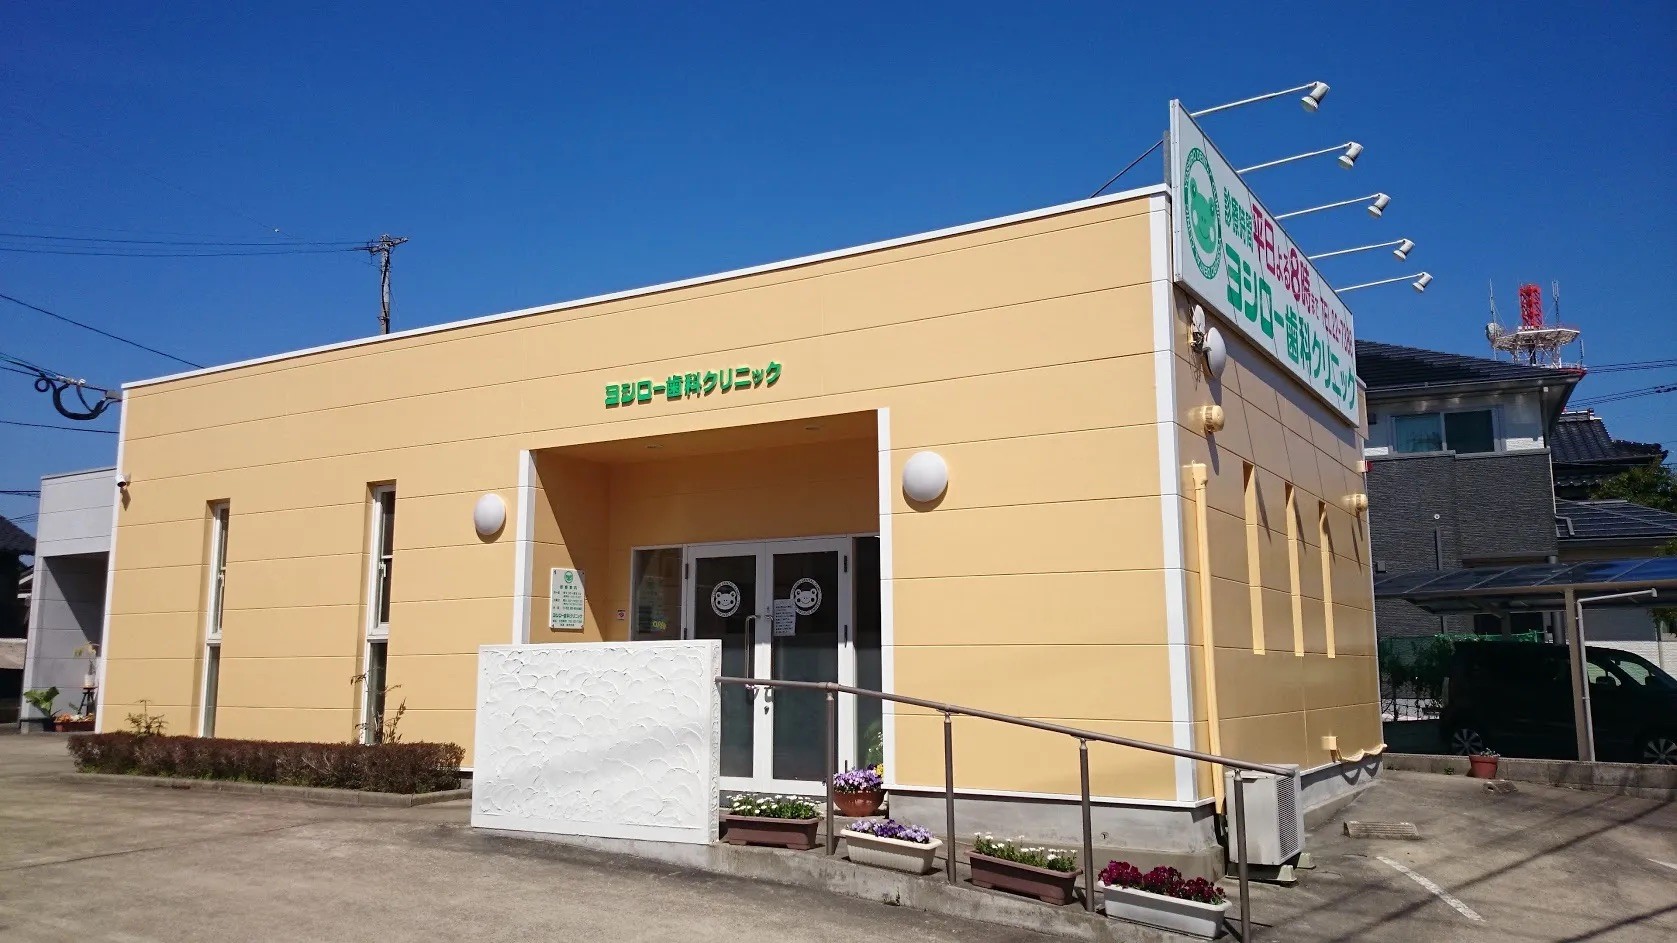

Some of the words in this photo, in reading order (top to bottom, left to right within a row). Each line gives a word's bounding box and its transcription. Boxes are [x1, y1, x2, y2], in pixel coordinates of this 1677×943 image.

[1225, 242, 1356, 410] ヨシロー歯科クリニック
[604, 361, 783, 406] ヨシロー歯科クリニック
